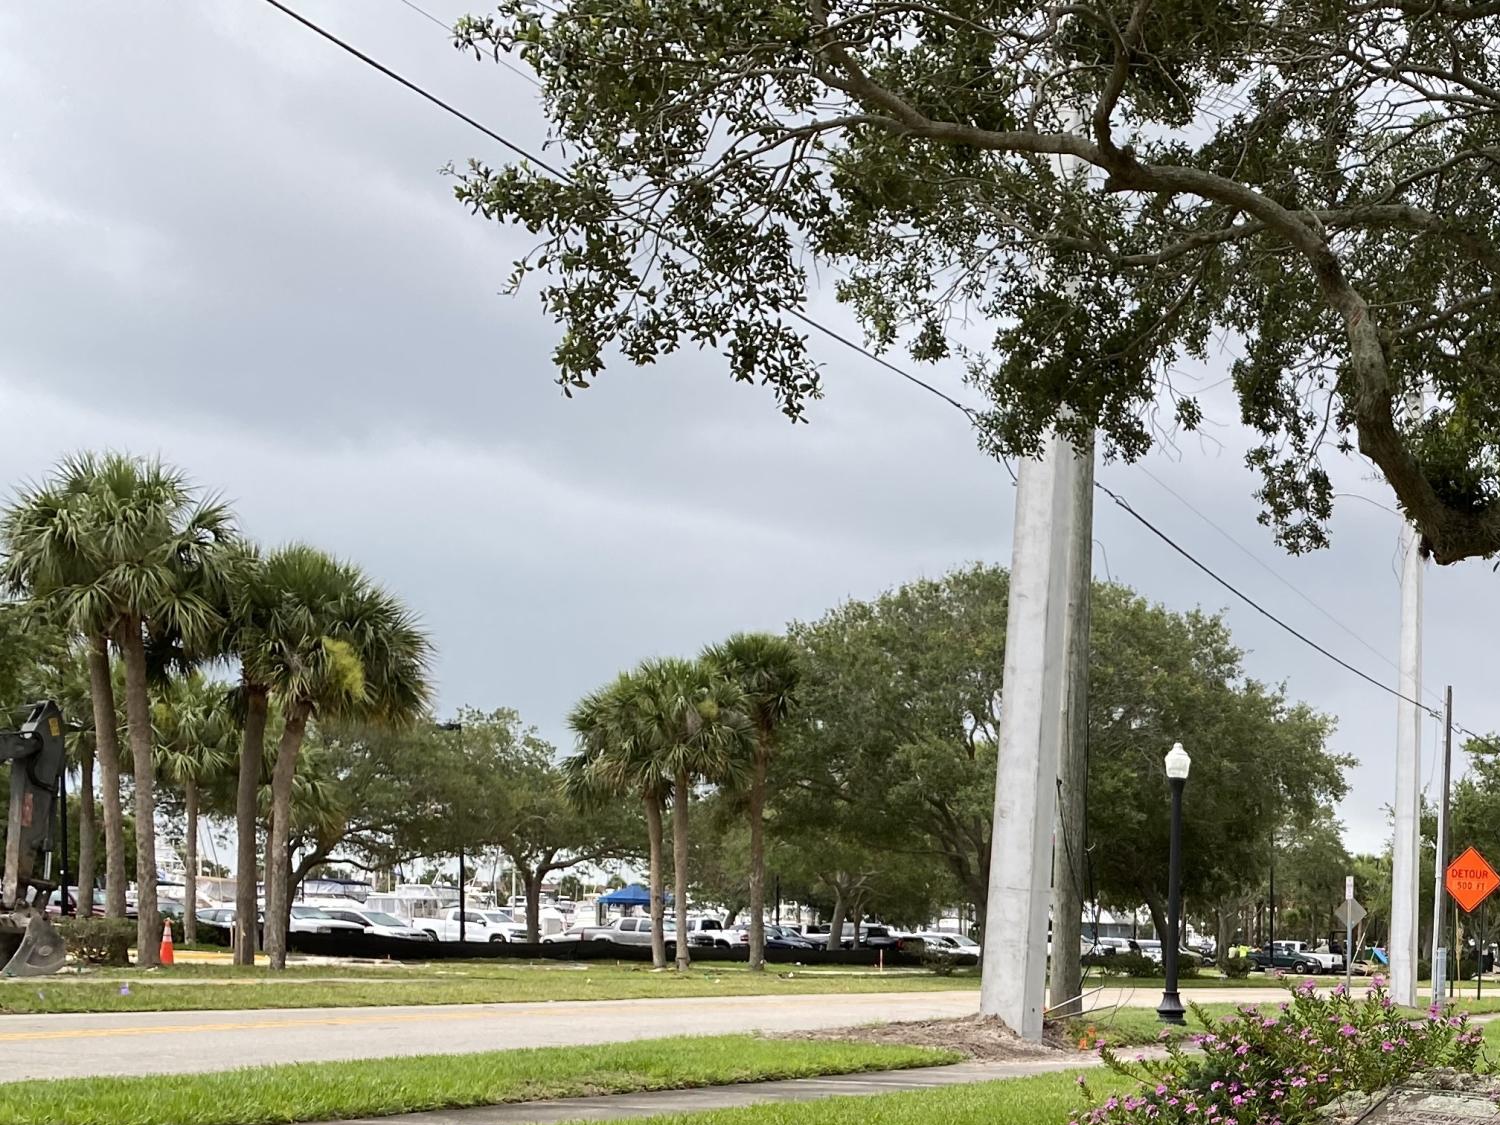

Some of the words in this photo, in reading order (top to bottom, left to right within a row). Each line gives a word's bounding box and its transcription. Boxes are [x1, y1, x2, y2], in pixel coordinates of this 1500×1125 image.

[1451, 869, 1488, 879] DETOUR
[1457, 882, 1473, 890] 500
[1478, 883, 1486, 891] FT
